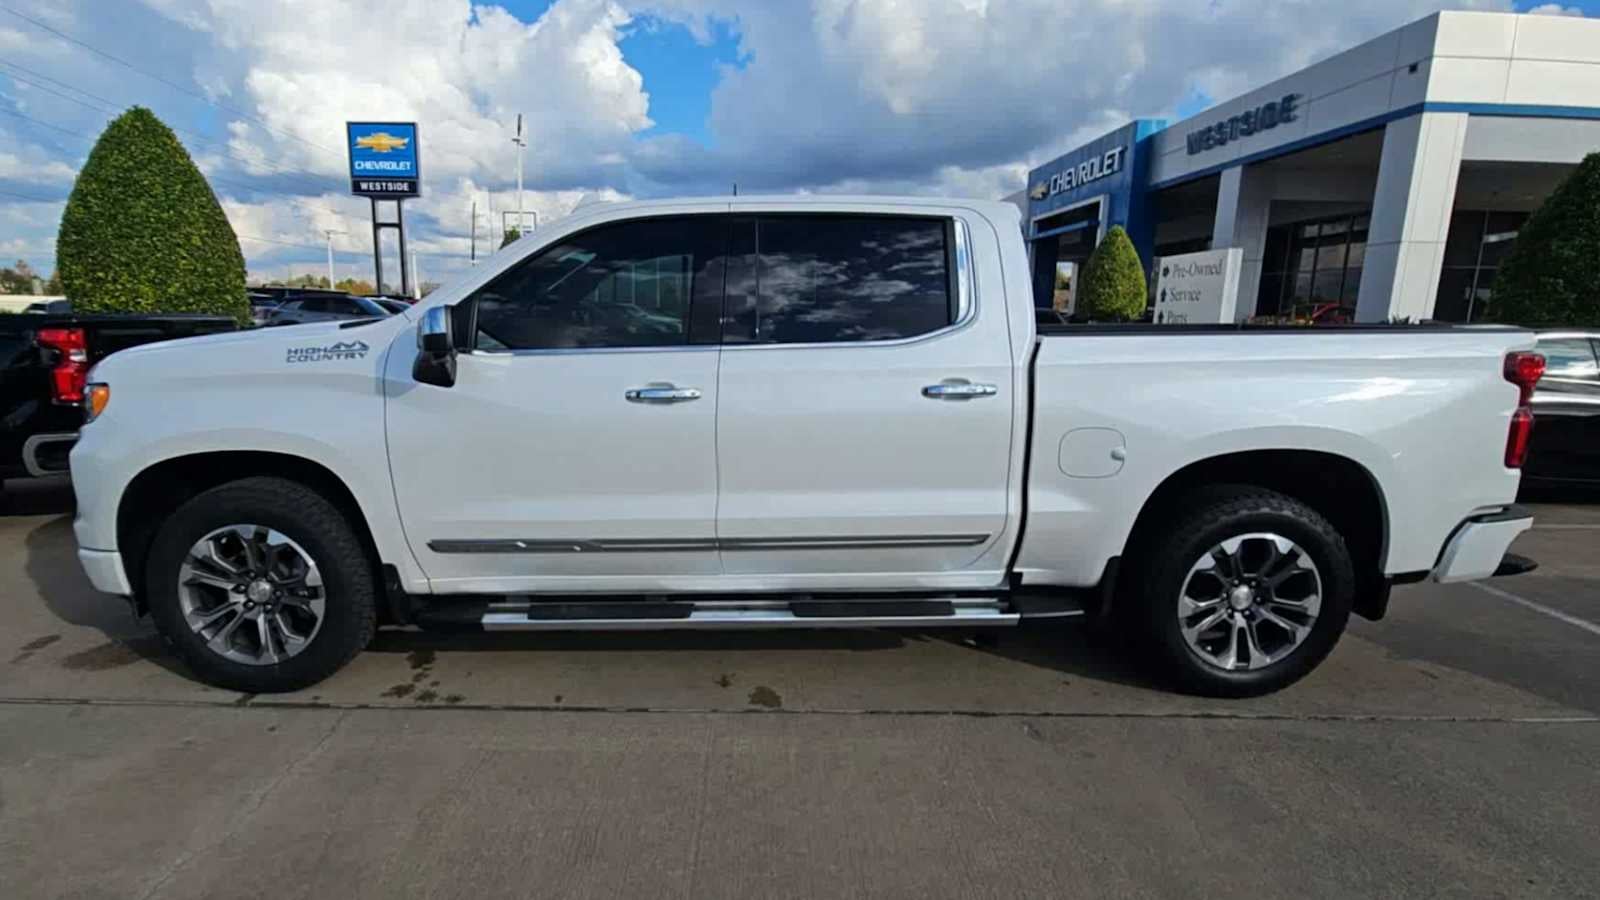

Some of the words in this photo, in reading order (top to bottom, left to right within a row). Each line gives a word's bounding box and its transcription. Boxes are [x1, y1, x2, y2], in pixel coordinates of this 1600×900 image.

[1186, 93, 1300, 155] WESTSIDE
[354, 161, 411, 170] CHEVROLET
[1050, 147, 1124, 195] CHEVROLET
[360, 182, 409, 191] WESTSIDE
[1172, 259, 1222, 278] Pre-Owned
[1169, 288, 1201, 303] Service
[287, 347, 327, 355] HIGH
[287, 352, 366, 363] COUNTRY
